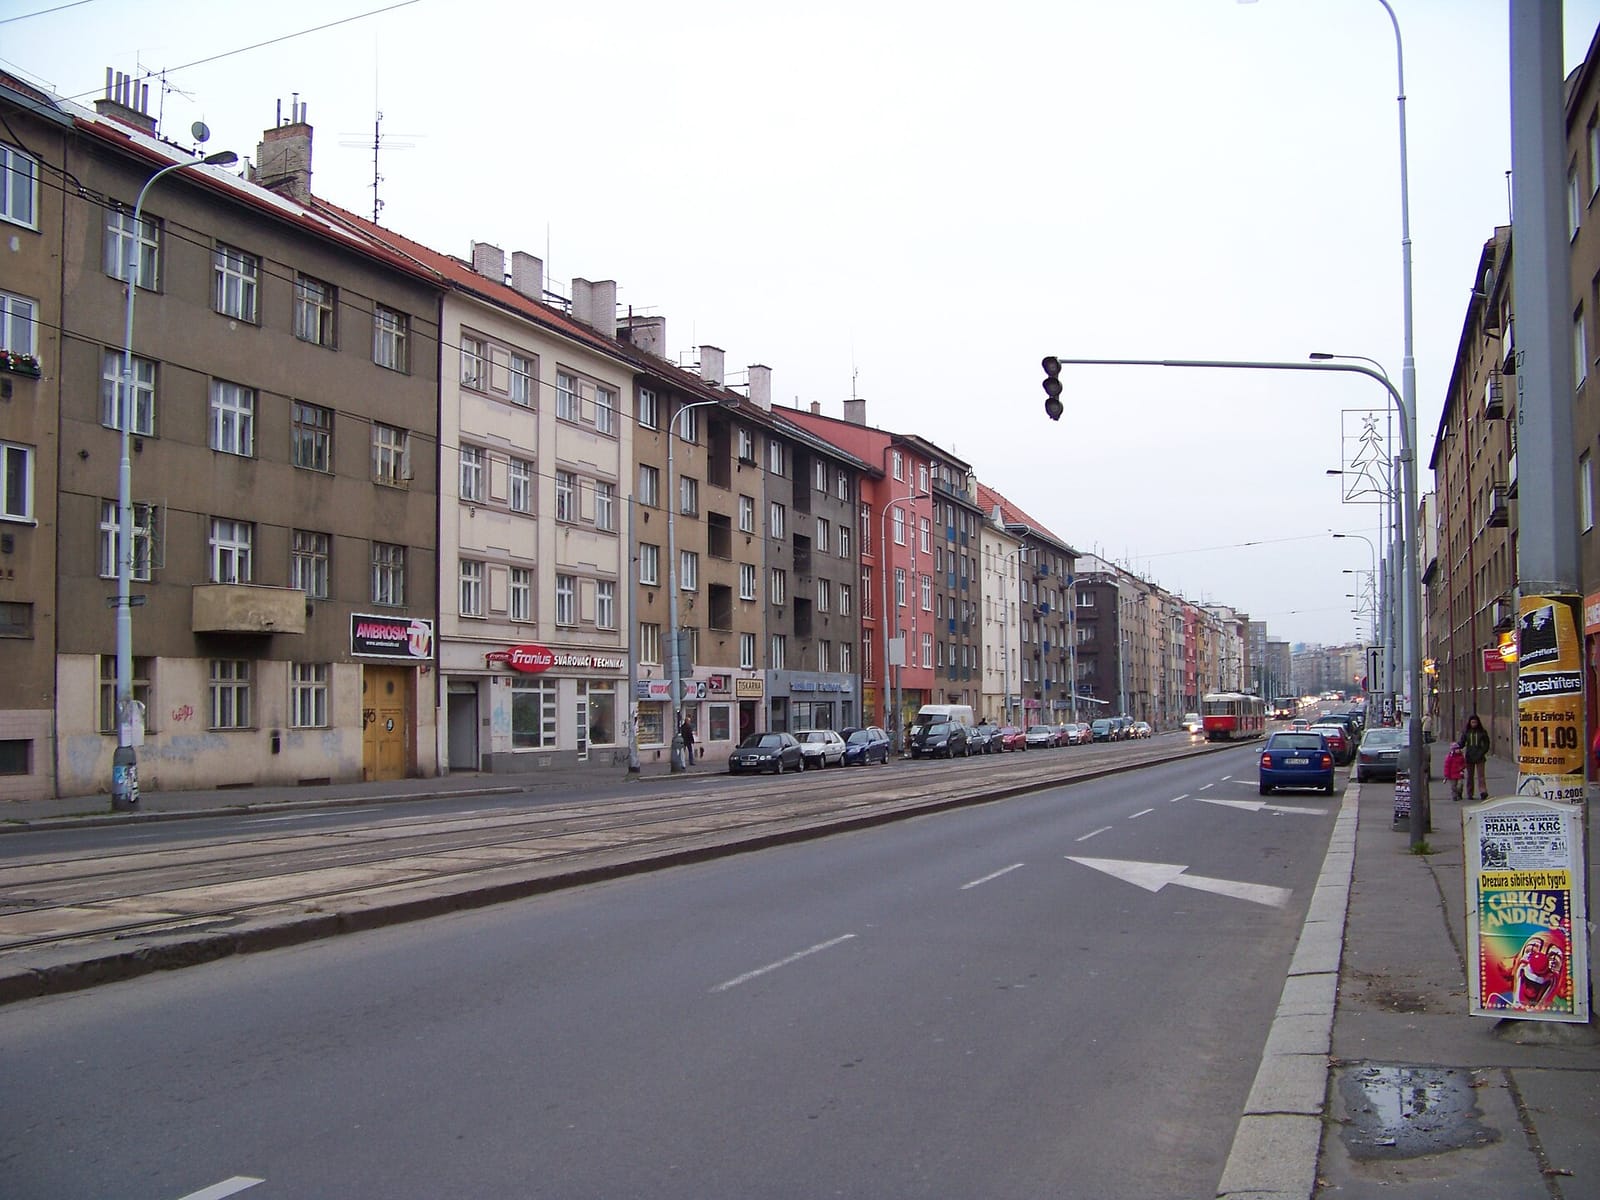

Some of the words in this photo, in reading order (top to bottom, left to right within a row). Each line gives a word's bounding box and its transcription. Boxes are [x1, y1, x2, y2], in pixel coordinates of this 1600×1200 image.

[356, 623, 408, 641] AMBROSIA
[511, 650, 552, 665] Fronius
[593, 656, 625, 669] TECHNIKA
[1533, 711, 1540, 721] &
[1485, 822, 1521, 832] PRAHA
[1529, 822, 1536, 831] 4
[1488, 891, 1557, 913] CIRKUS
[1487, 908, 1561, 930] ANDRES
